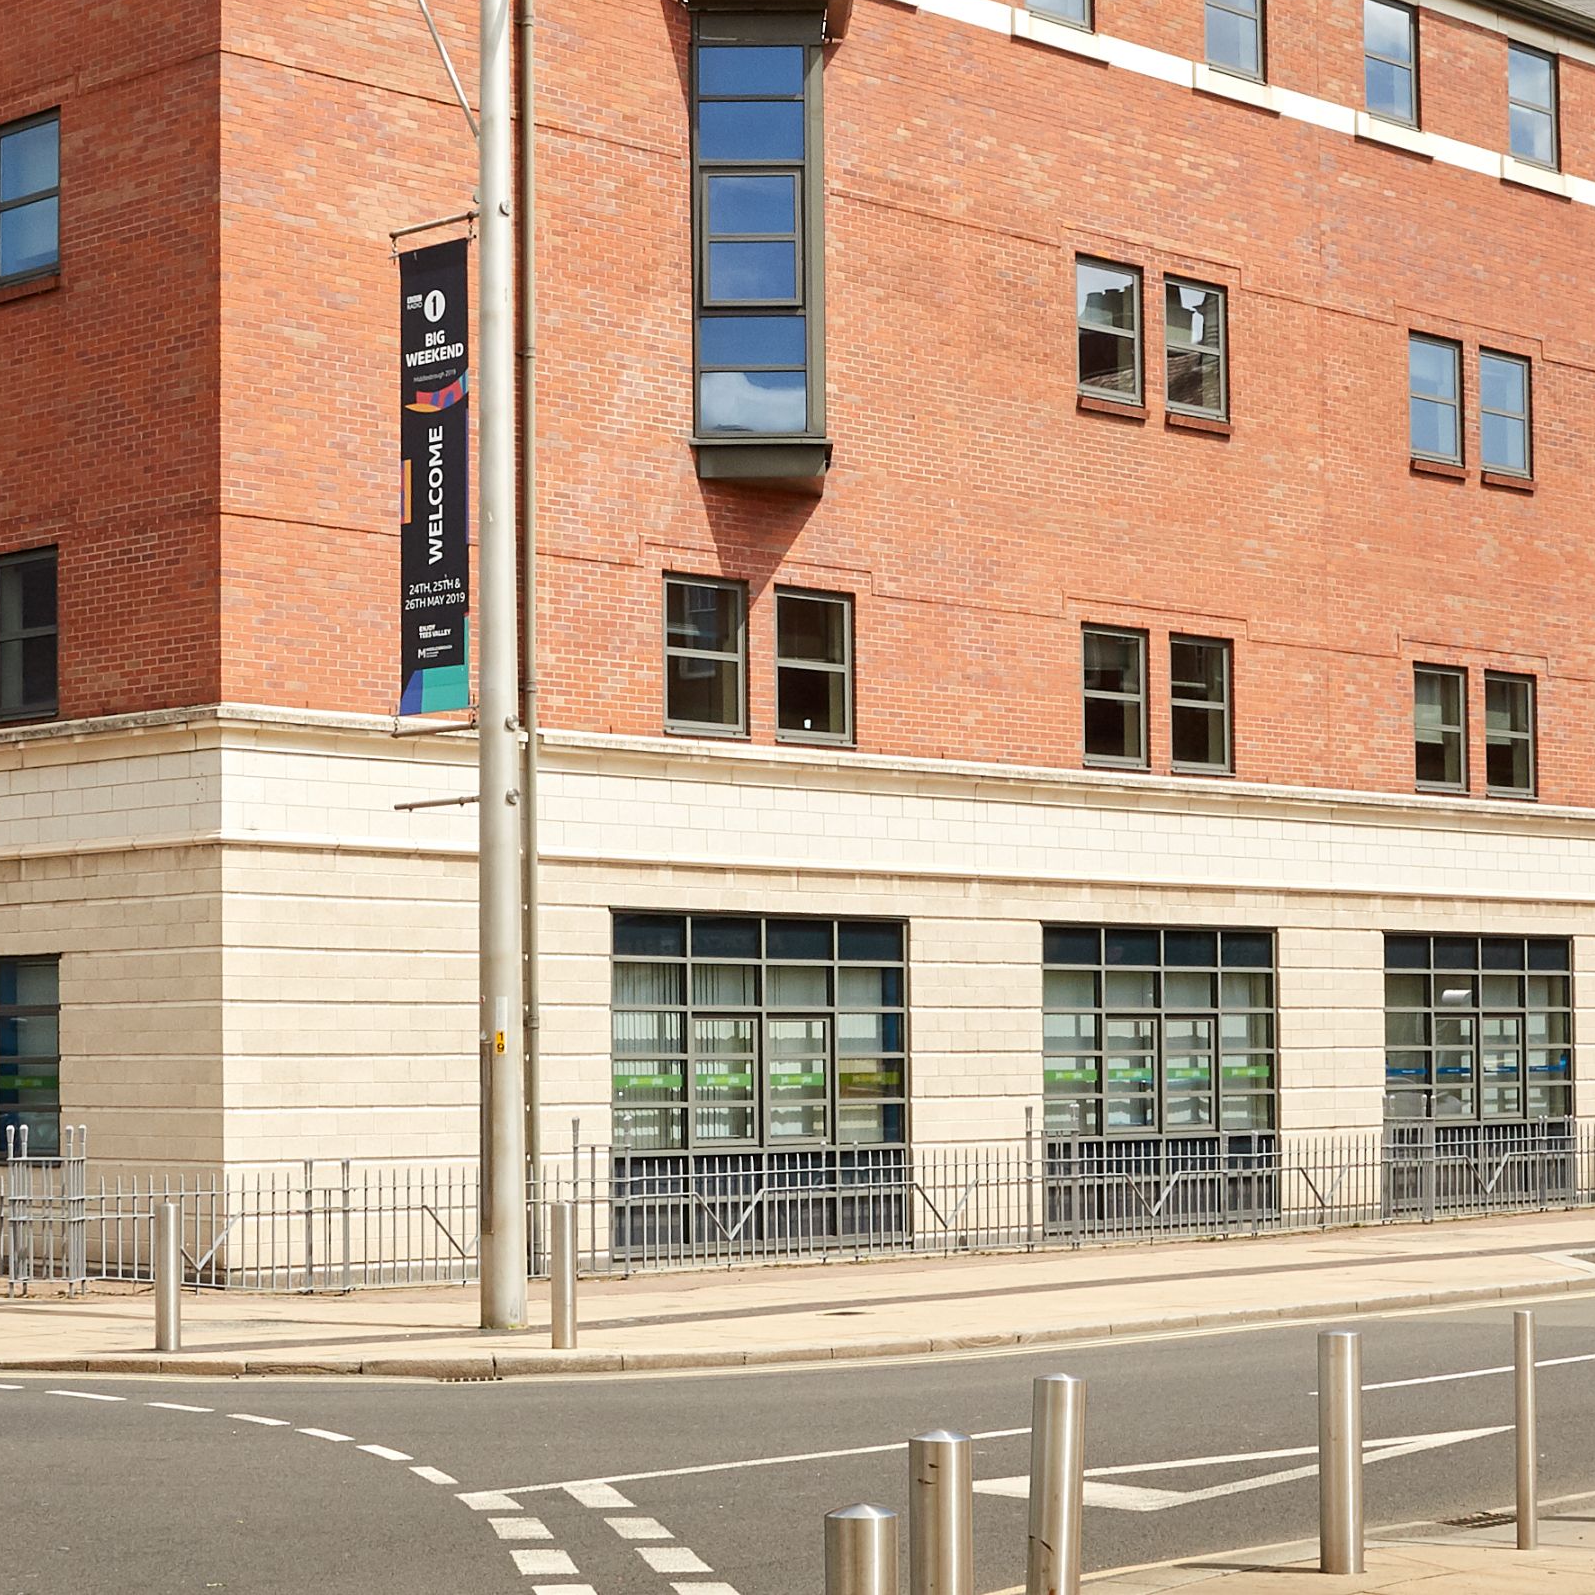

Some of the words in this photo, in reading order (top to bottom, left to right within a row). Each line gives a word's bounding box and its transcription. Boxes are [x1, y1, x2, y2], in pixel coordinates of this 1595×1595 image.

[425, 329, 446, 348] BIG
[405, 342, 464, 368] WEEKEND
[428, 425, 444, 565] WELCOME
[409, 582, 432, 595] 24TH,
[432, 578, 454, 592] 25TH
[454, 577, 461, 589] &
[405, 597, 426, 610] 26TH
[427, 595, 444, 607] MAY
[445, 591, 466, 605] 2019
